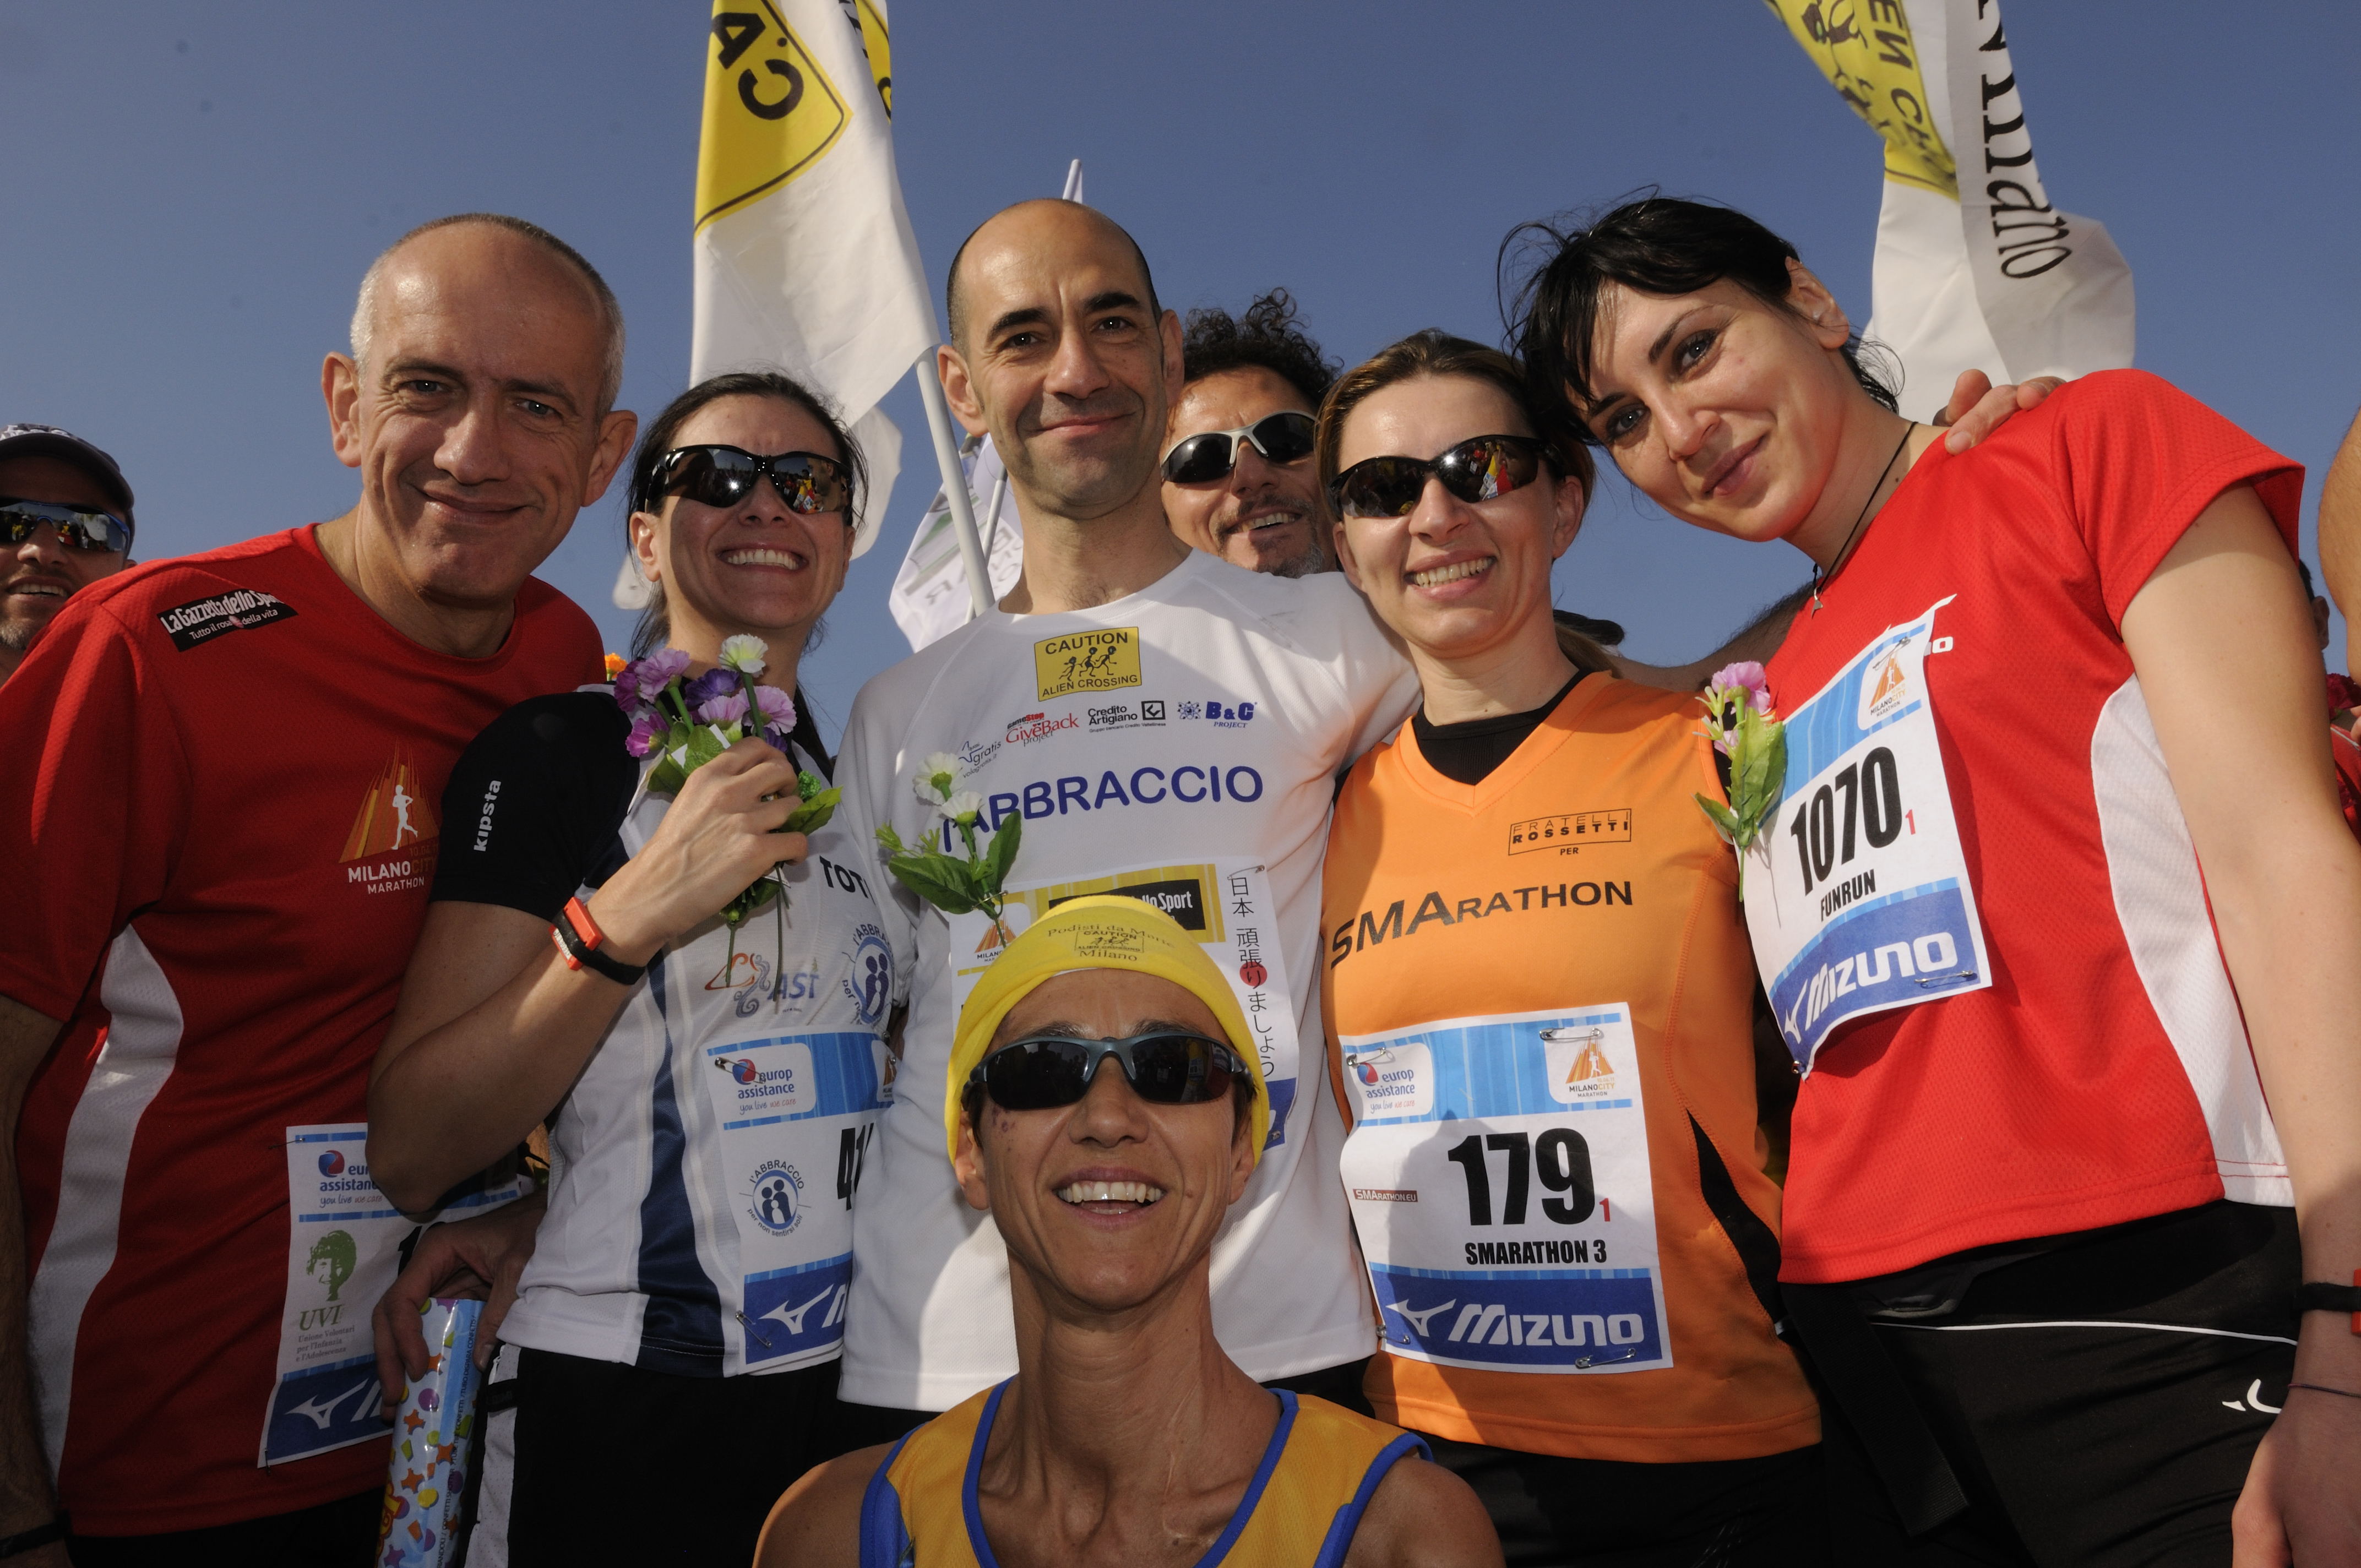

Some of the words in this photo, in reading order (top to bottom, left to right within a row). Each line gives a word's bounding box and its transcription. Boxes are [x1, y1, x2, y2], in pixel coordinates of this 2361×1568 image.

[189, 627, 211, 640] Tutto
[210, 623, 217, 632] il
[242, 613, 262, 625] della
[262, 609, 278, 619] vita
[1045, 632, 1128, 654] CAUTION
[1042, 682, 1074, 697] ALIEN
[1078, 674, 1138, 688] CROSSING
[1088, 705, 1127, 717] Credito
[1876, 700, 1900, 717] MARATHON
[1089, 713, 1138, 725] Artigiano
[1024, 731, 1053, 747] project
[973, 741, 1001, 766] gratis
[474, 780, 502, 852] kipsta
[1514, 812, 1628, 834] FRATELLI
[1791, 747, 1902, 896] 1070
[1905, 809, 1916, 835] 1
[1513, 821, 1628, 844] ROSSETTI
[1560, 847, 1579, 856] PER
[367, 876, 424, 895] MARATHON
[1158, 891, 1193, 912] Sport
[1231, 876, 1254, 918] 日本
[1820, 869, 1876, 922] FUNRUN
[1048, 924, 1100, 937] Podisti
[1084, 930, 1136, 940] CAUTION
[1080, 950, 1138, 961] Milano
[759, 1069, 792, 1081] europ
[1382, 1069, 1414, 1082] europ
[738, 1084, 795, 1099] assistance
[1366, 1084, 1415, 1098] assistance
[739, 1104, 753, 1115] you
[755, 1100, 767, 1110] live
[1370, 1103, 1381, 1114] you
[1383, 1100, 1392, 1109] live
[348, 1165, 370, 1175] eur
[749, 1159, 804, 1189] l'ABBRACCIO
[1448, 1128, 1595, 1226] 179
[1599, 1197, 1611, 1222] 1
[320, 1178, 380, 1191] assistan
[319, 1196, 336, 1208] you
[338, 1194, 352, 1204] live
[747, 1208, 758, 1222] per
[758, 1222, 770, 1234] non
[772, 1226, 795, 1237] sentirsi
[794, 1215, 803, 1228] soli
[1465, 1240, 1588, 1265] SMARATHON
[1593, 1239, 1607, 1263] 3
[300, 1304, 344, 1331] UVI
[298, 1333, 323, 1342] Unione
[325, 1325, 355, 1337] Volontari
[297, 1346, 309, 1354] per
